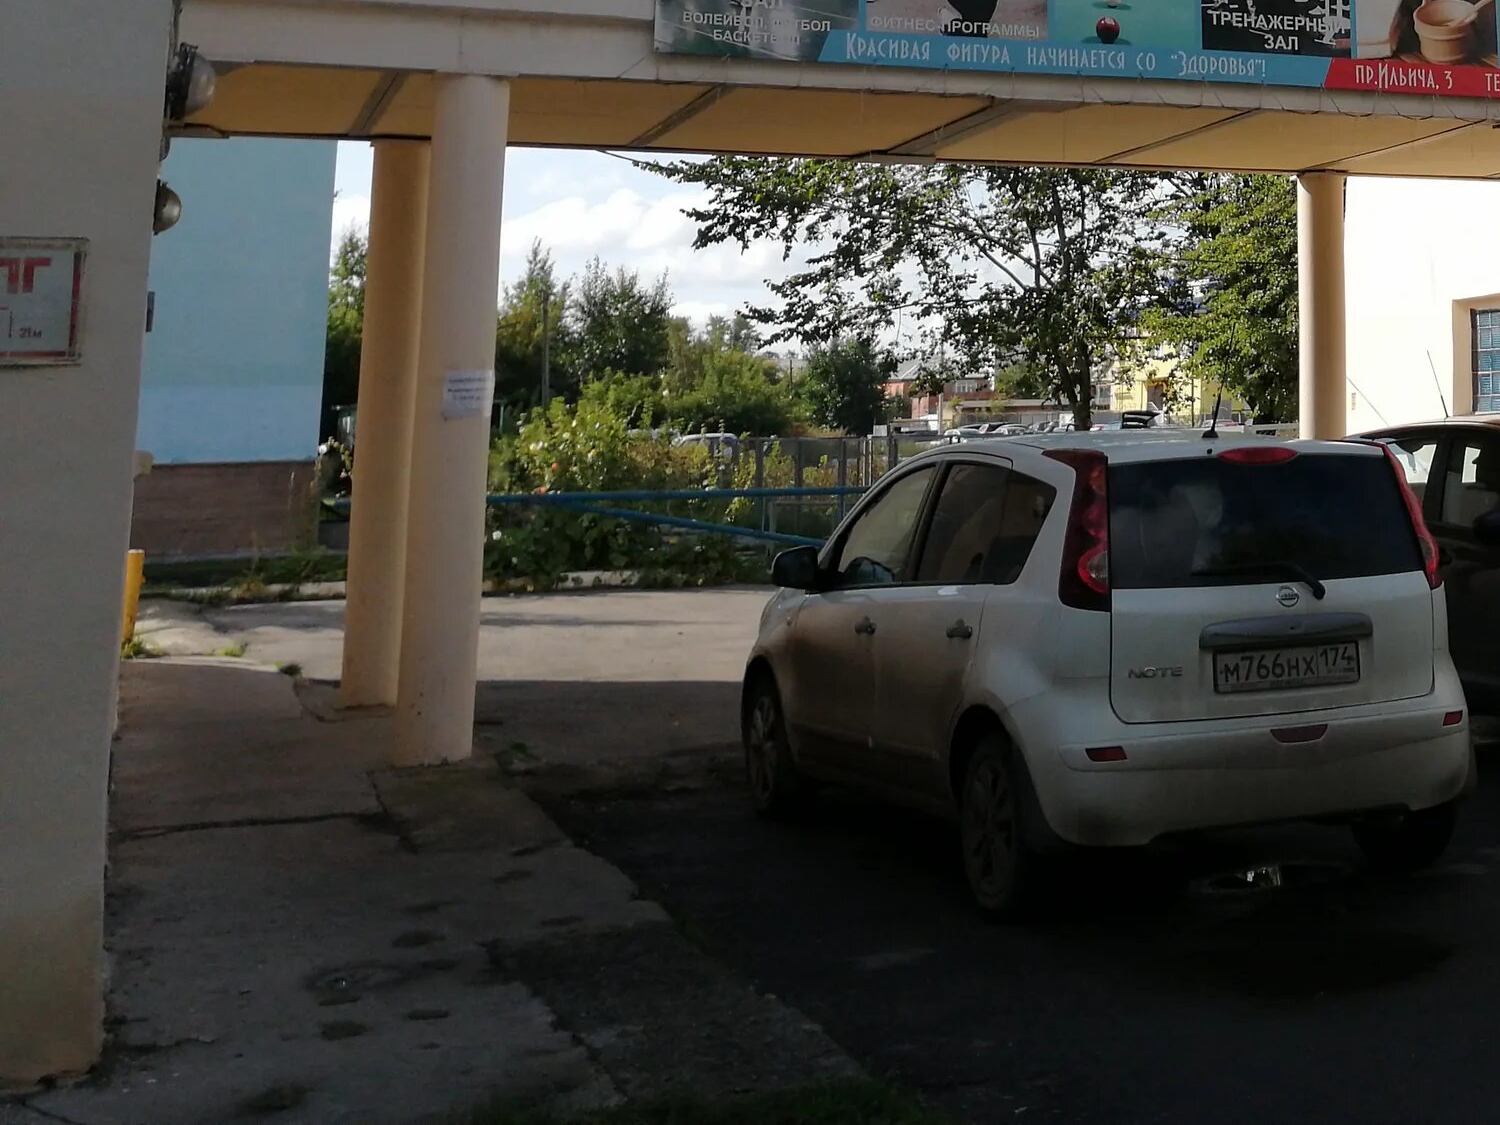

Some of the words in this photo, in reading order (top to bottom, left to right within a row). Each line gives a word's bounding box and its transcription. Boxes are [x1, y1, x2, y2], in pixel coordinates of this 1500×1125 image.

[773, 18, 831, 32] ФТБОЛ
[1264, 35, 1298, 51] ЗАЛ
[1444, 70, 1453, 89] 3
[1320, 645, 1355, 667] 174
[1128, 666, 1183, 679] NOTE
